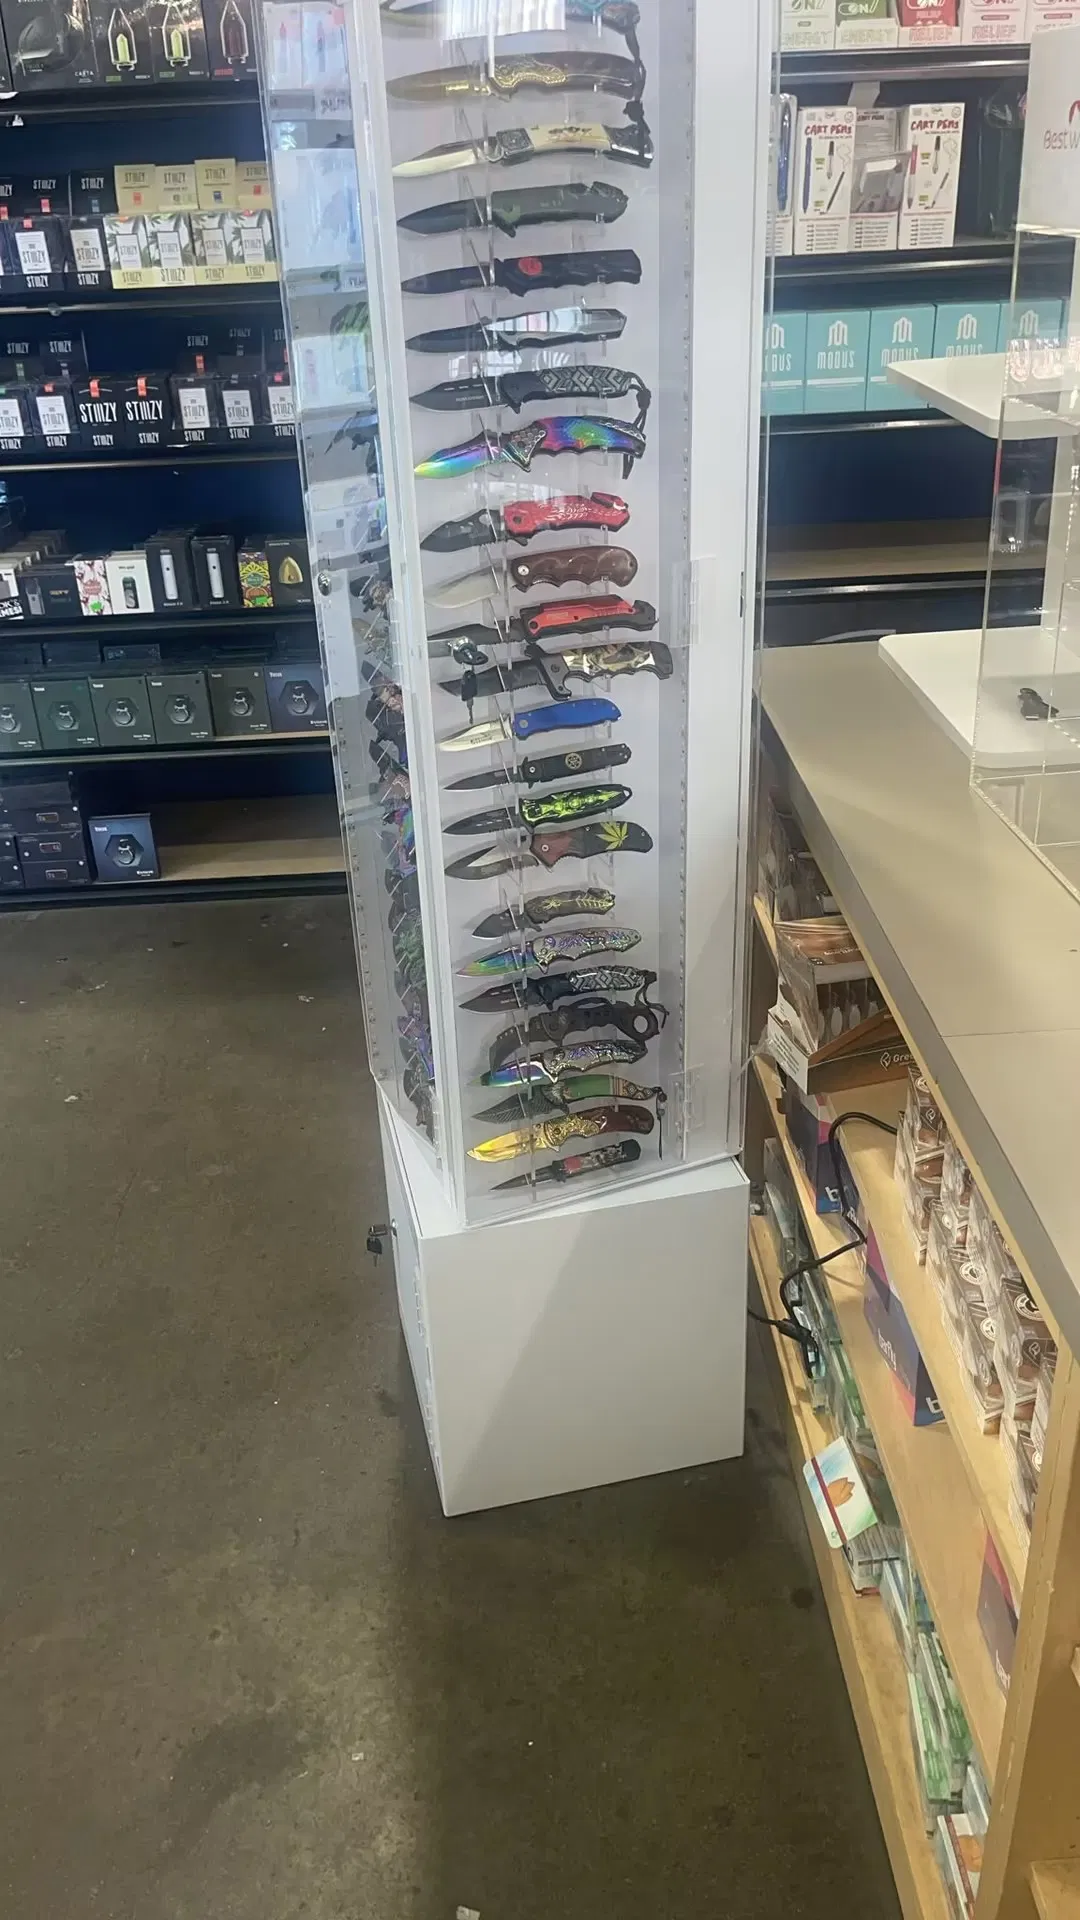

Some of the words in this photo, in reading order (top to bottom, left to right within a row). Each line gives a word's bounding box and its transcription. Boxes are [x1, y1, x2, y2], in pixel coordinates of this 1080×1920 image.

[804, 124, 829, 136] CART
[910, 119, 935, 131] CART
[817, 350, 855, 369] MODUS
